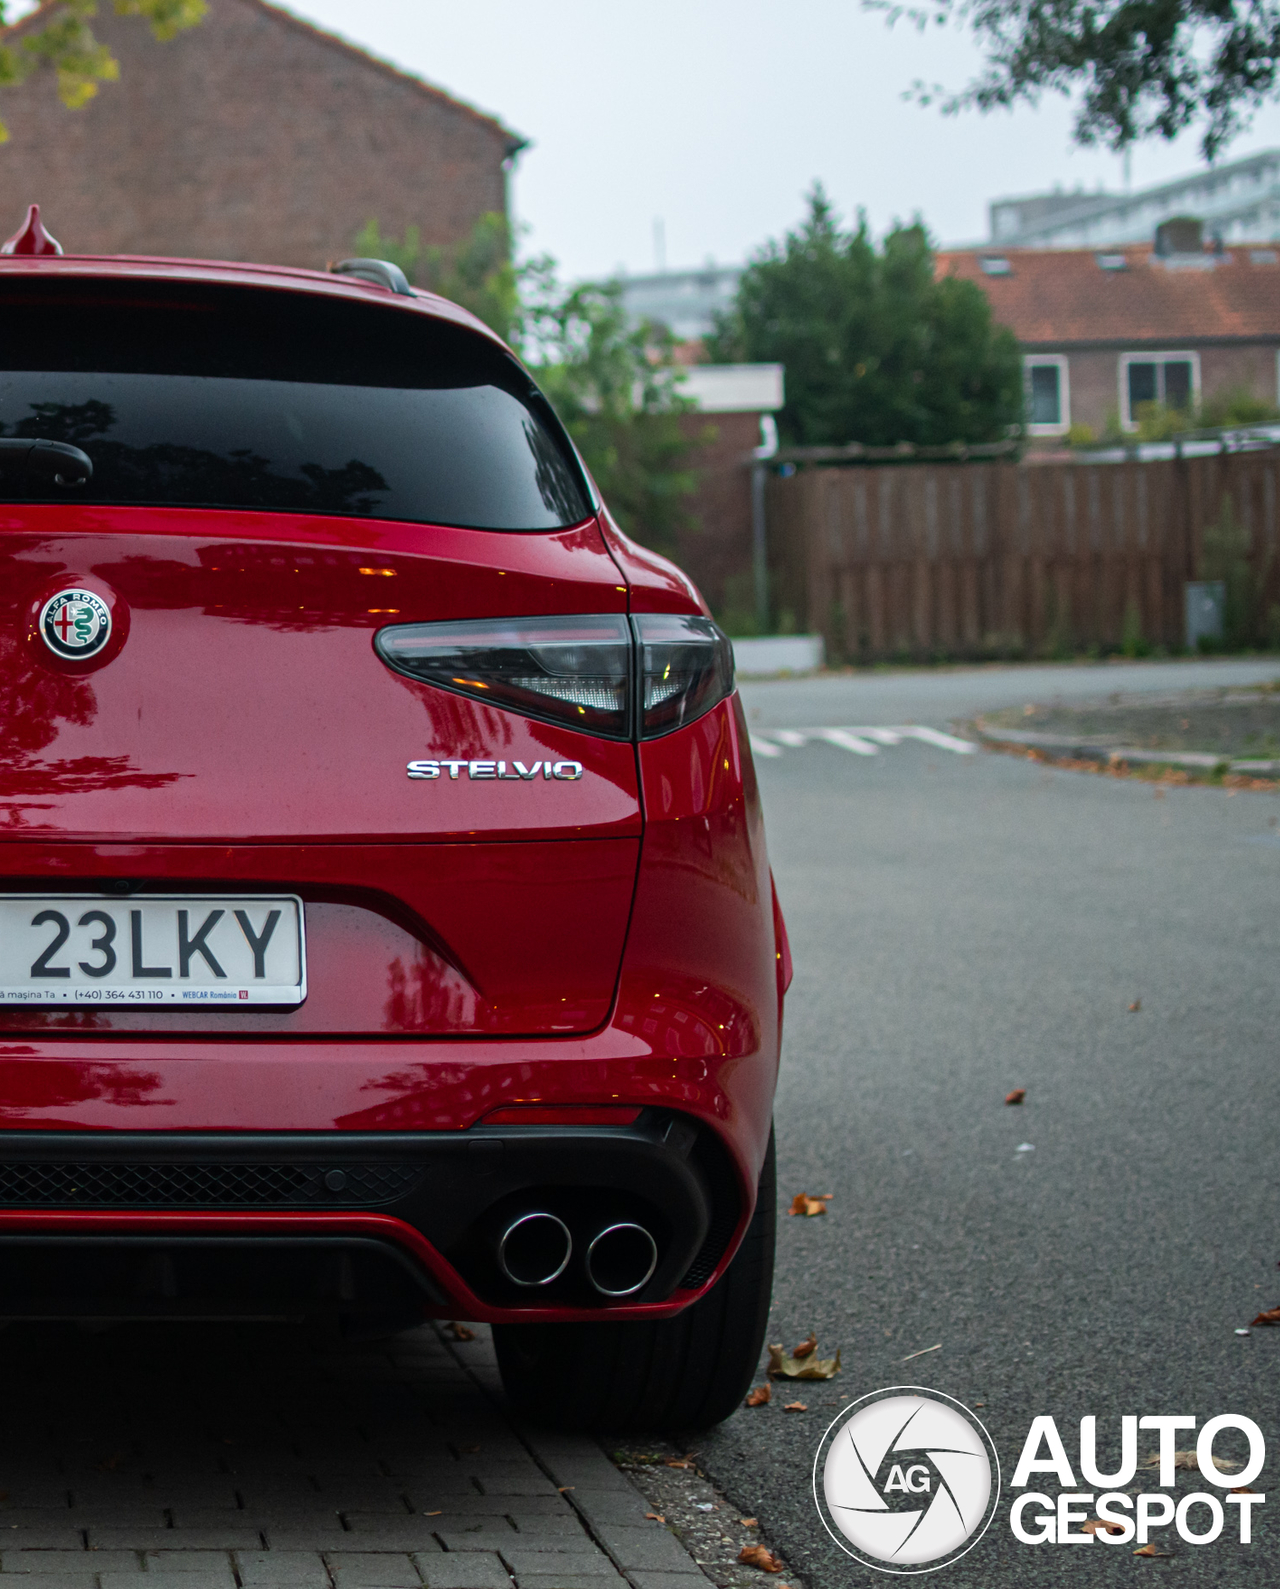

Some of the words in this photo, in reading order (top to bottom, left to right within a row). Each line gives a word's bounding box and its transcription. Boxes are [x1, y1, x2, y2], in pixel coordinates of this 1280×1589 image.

[47, 597, 68, 624] ALFA
[73, 593, 107, 626] ROMEO
[407, 760, 583, 780] STELVIO
[44, 990, 55, 999] Ta
[74, 989, 102, 1000] (+40)
[105, 990, 125, 999] 364
[128, 990, 145, 999] 431
[148, 990, 163, 999] 110
[182, 990, 208, 999] WEBCAR
